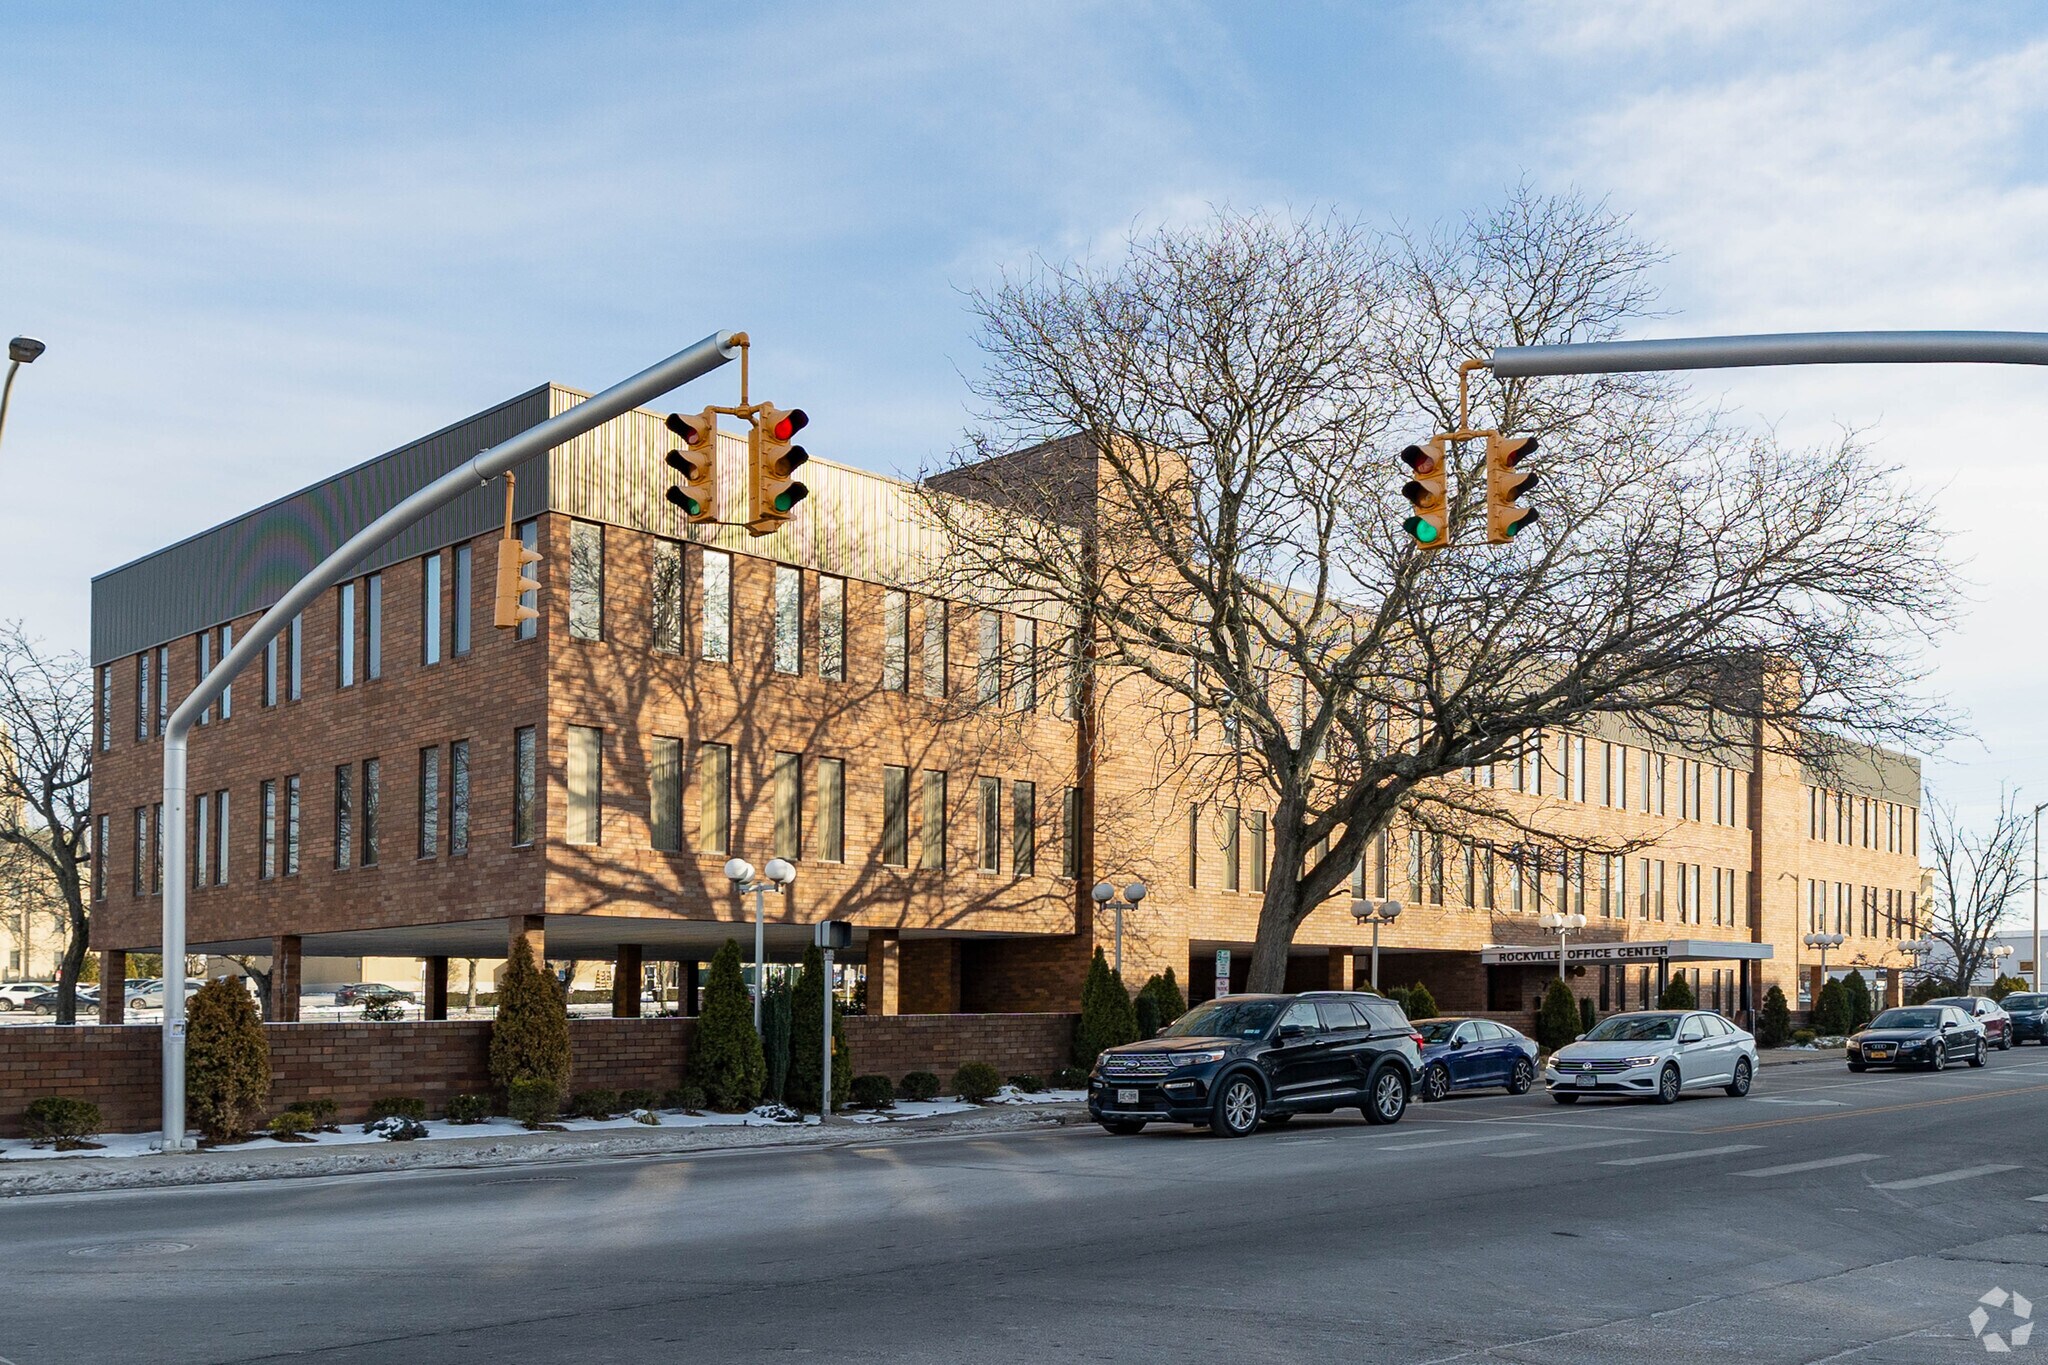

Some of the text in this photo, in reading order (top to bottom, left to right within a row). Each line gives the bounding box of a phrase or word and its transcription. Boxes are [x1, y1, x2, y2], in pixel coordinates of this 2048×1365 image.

[1499, 946, 1668, 962] ROCKVILLE OFFICE CENTER
